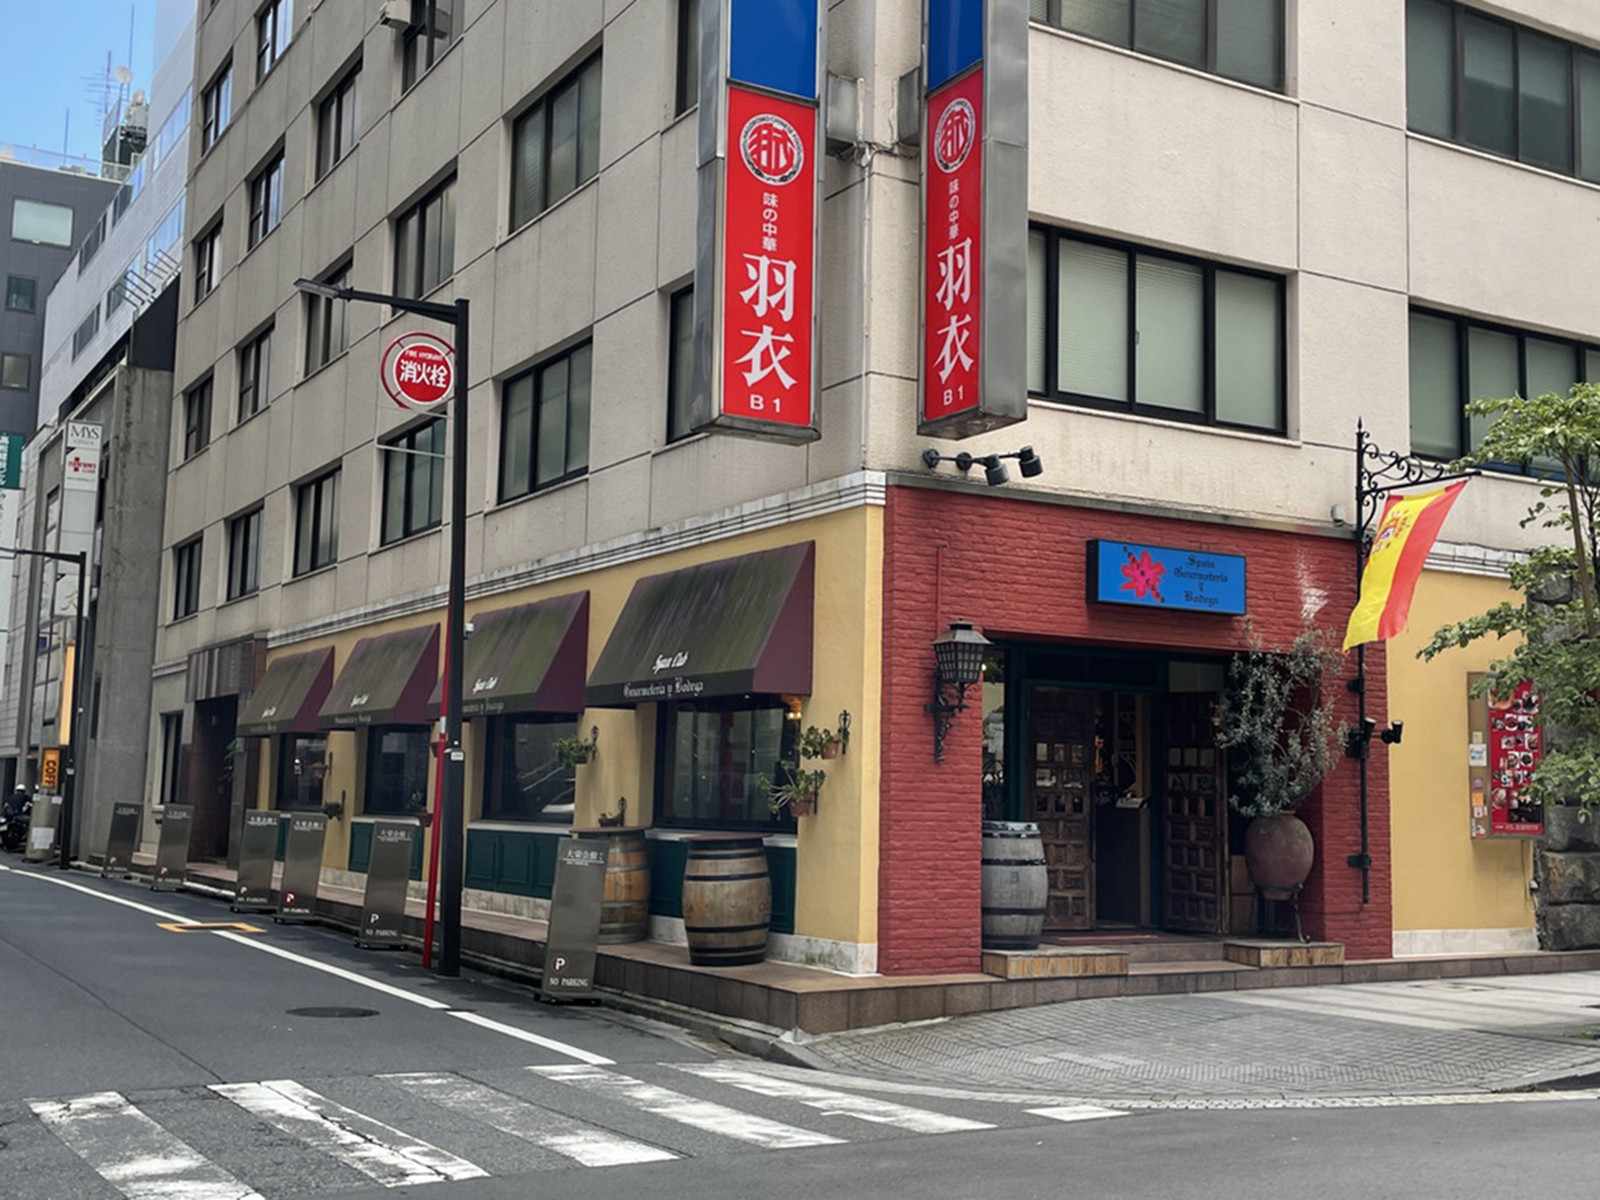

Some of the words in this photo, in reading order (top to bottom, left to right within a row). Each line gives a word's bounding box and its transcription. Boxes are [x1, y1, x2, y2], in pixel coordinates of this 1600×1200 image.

[762, 191, 779, 252] 味の中華
[949, 178, 960, 240] 味の中華
[733, 252, 799, 390] 羽衣
[932, 236, 975, 385] 羽衣
[400, 359, 448, 388] 消火栓
[70, 424, 100, 440] MYS
[1188, 555, 1215, 568] Spain
[549, 977, 560, 986] NO
[561, 978, 589, 987] PARKING
